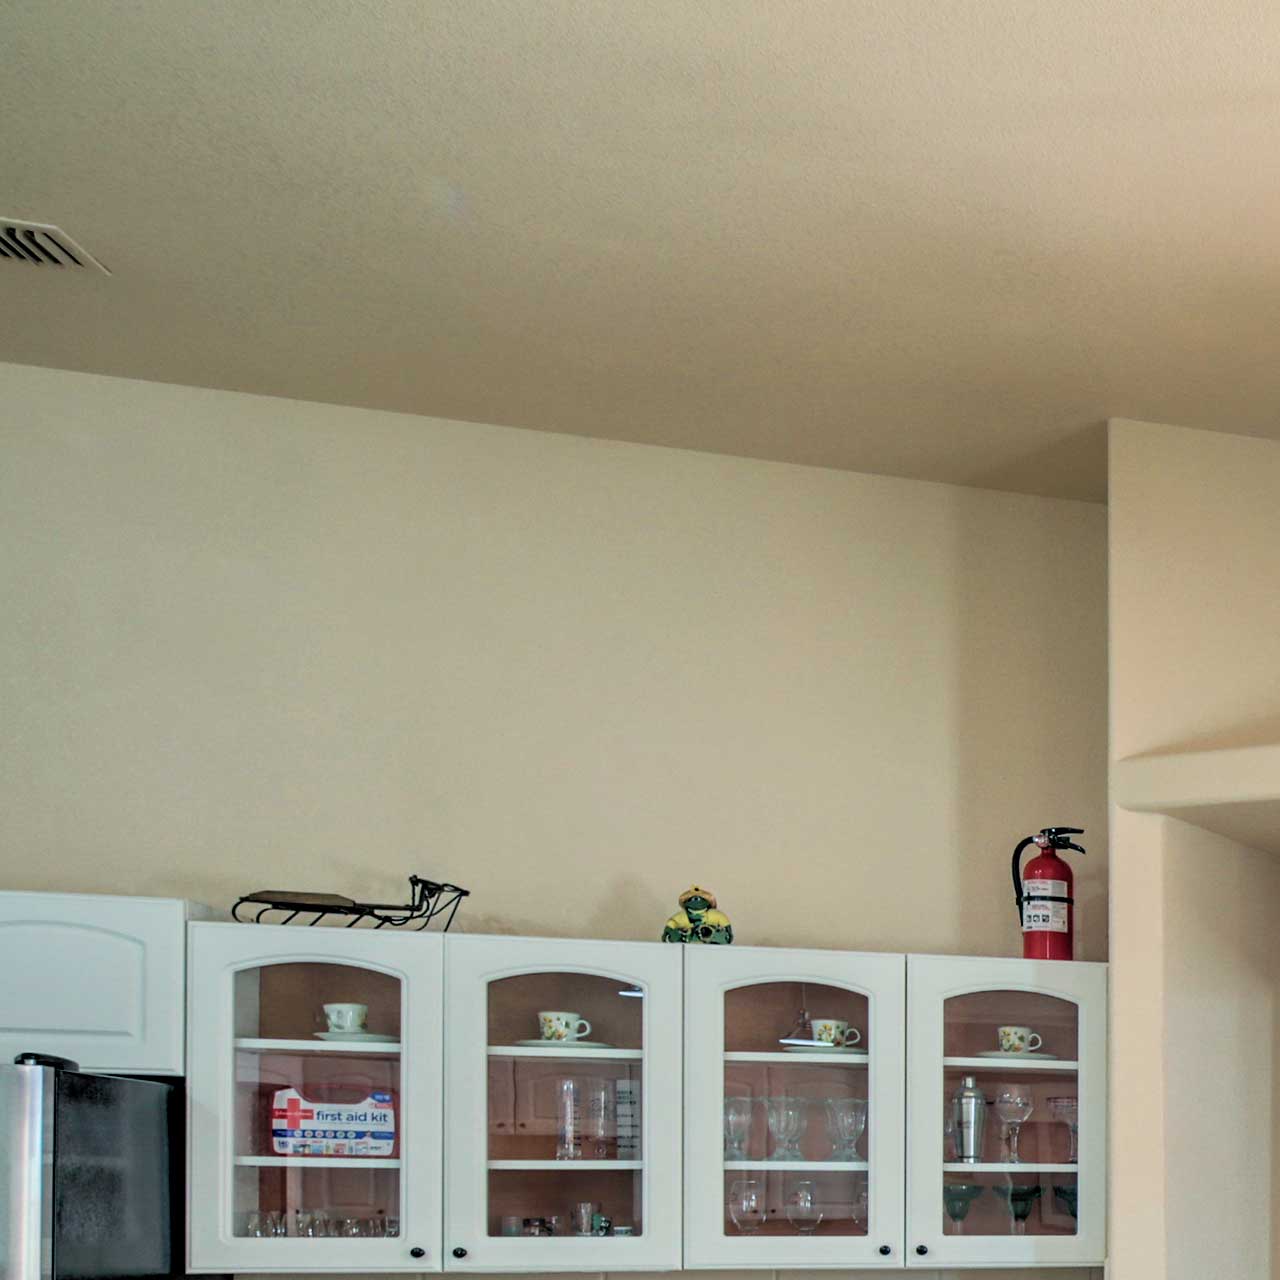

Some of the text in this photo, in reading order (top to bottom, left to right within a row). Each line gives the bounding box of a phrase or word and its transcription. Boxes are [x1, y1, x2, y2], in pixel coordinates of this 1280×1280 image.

[316, 1110, 341, 1122] first
[346, 1111, 367, 1122] aid
[371, 1110, 388, 1122] kit
